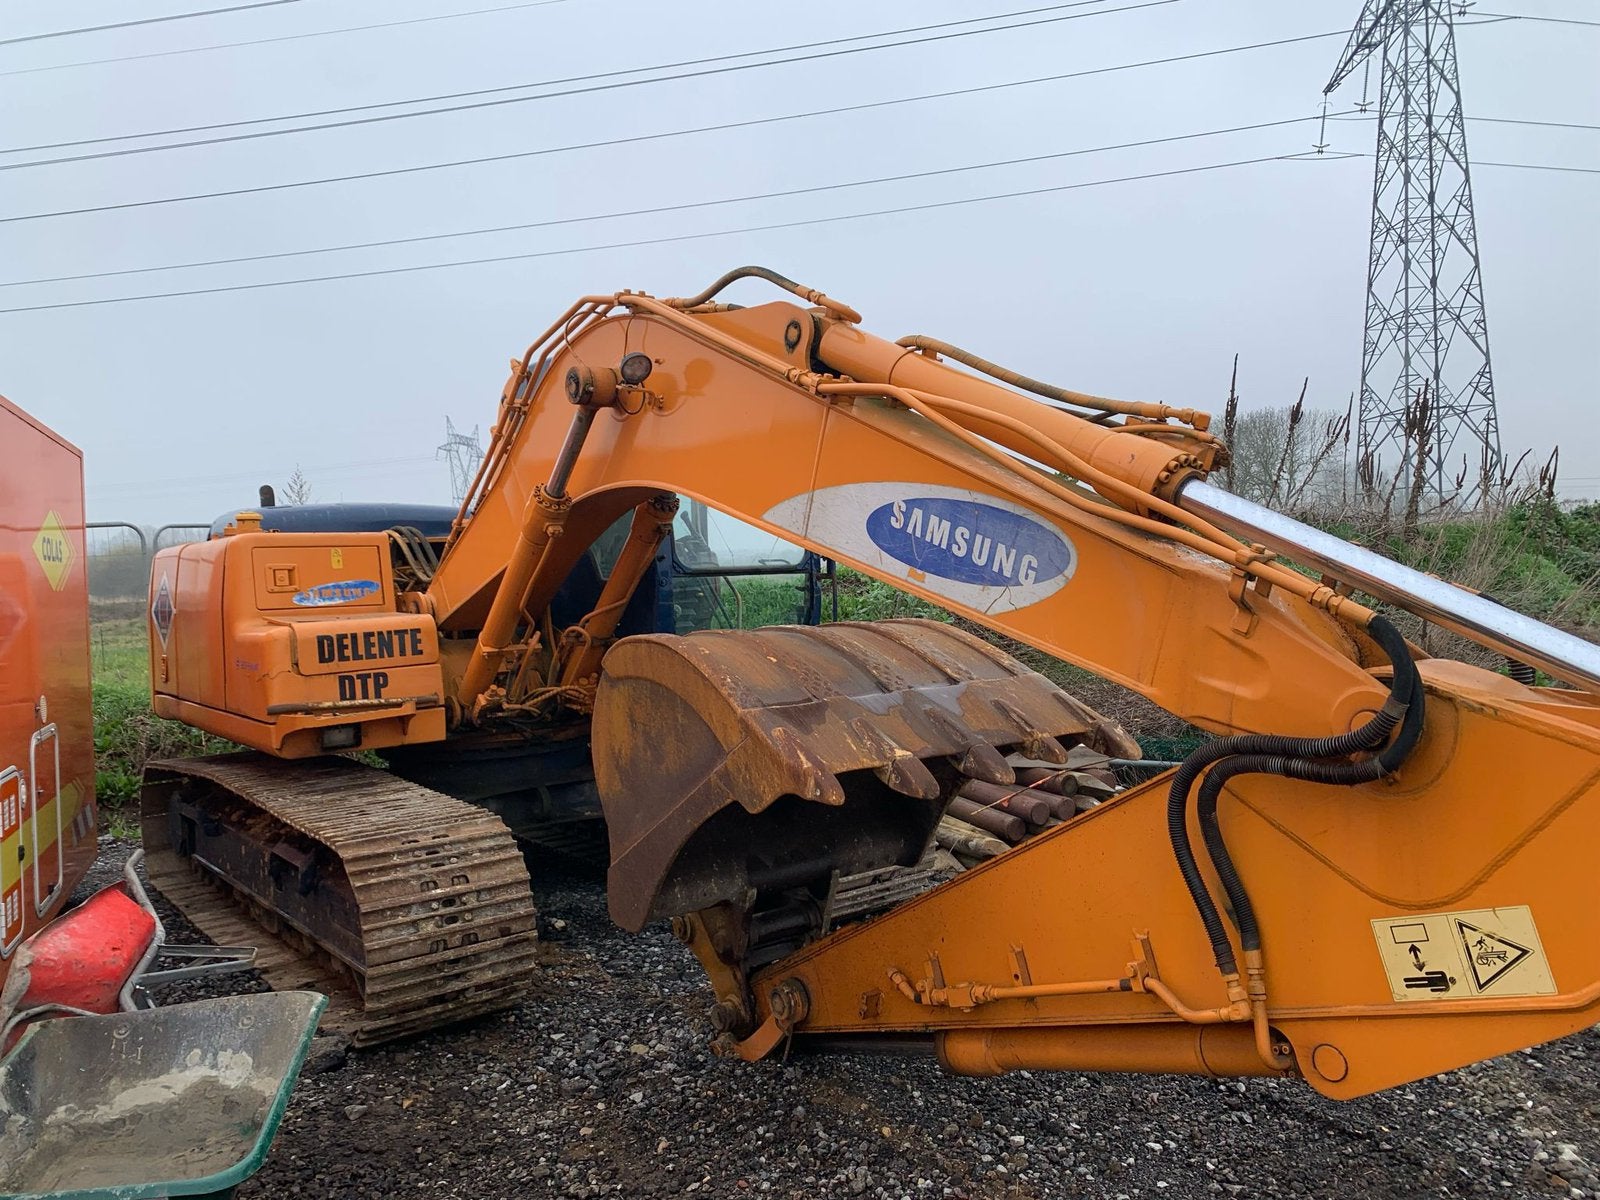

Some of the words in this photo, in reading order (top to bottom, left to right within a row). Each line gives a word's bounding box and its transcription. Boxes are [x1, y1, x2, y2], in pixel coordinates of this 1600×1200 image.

[41, 536, 63, 563] COLAS
[890, 500, 1038, 585] SAMSUNG
[316, 628, 424, 664] DELENTE
[338, 672, 389, 701] DTP
